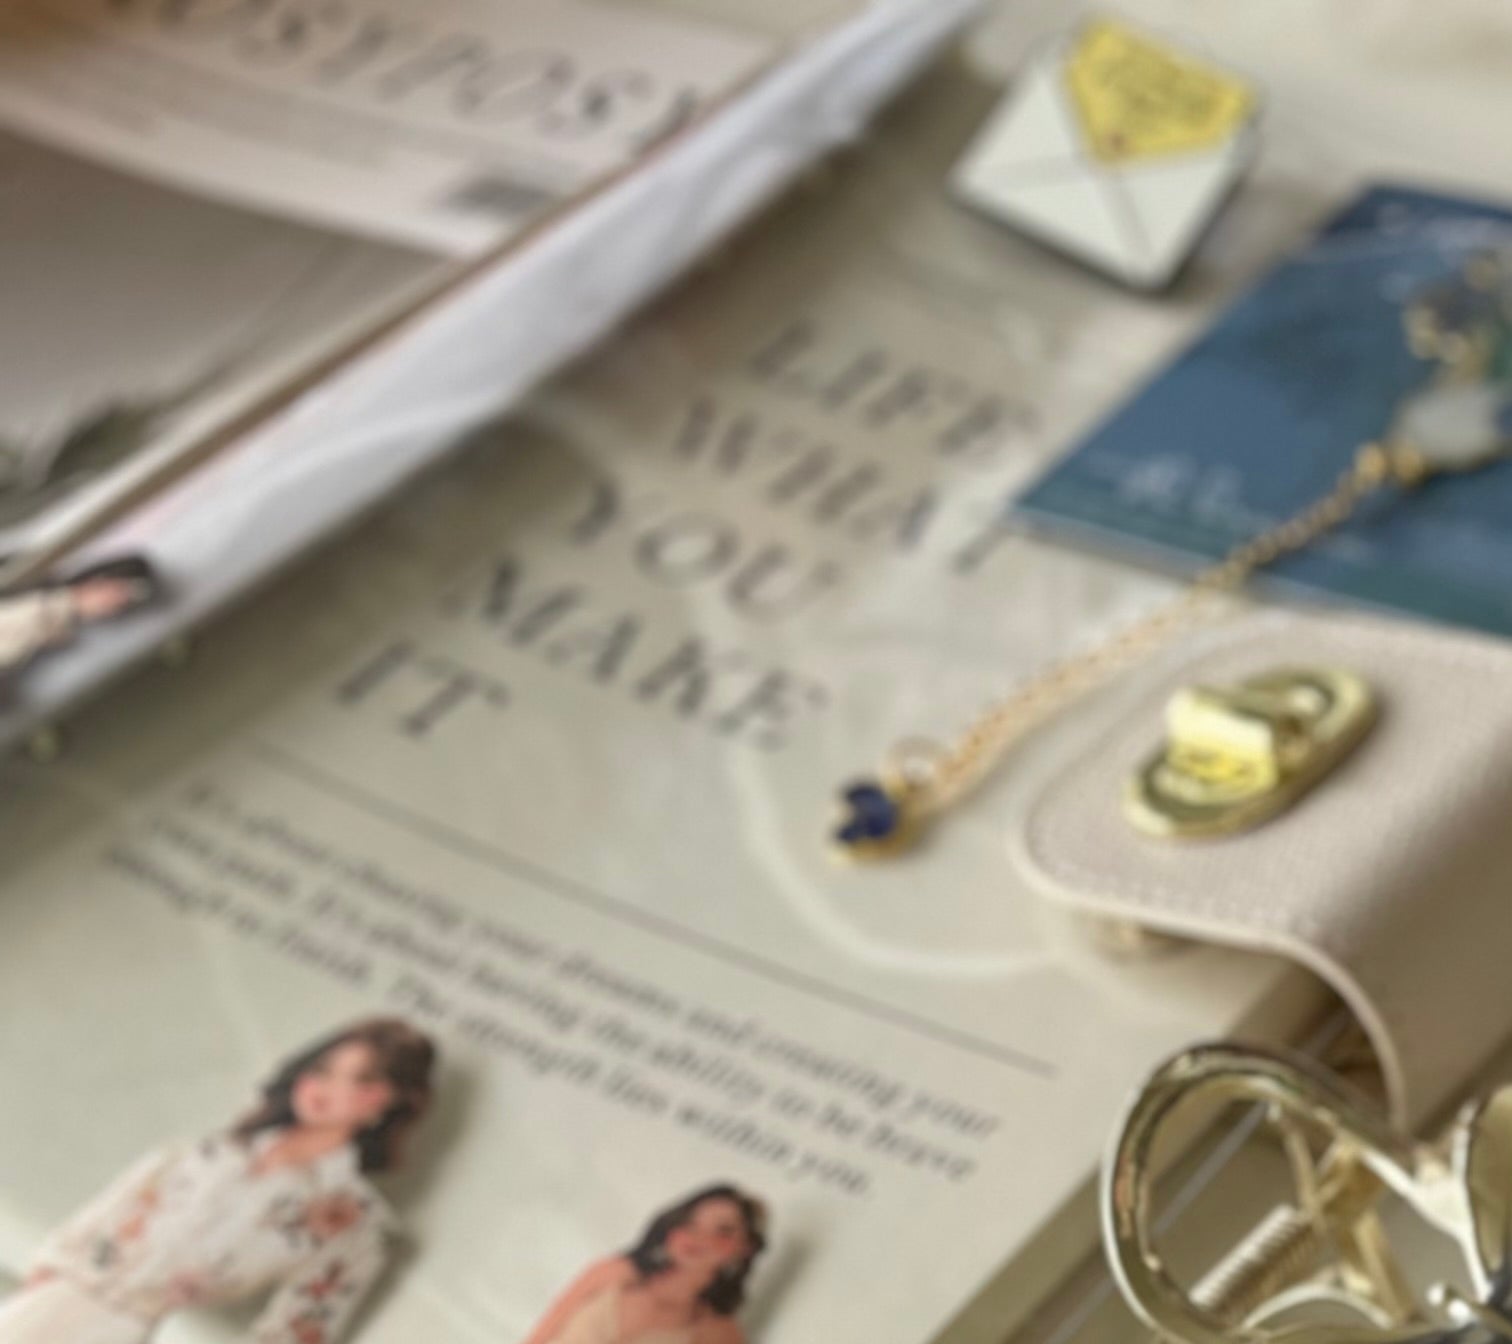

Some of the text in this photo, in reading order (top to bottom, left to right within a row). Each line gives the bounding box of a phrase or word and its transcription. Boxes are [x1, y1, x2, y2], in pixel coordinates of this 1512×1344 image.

[742, 315, 1045, 462] LIFE
[560, 470, 848, 624] YOU
[332, 634, 511, 742] IT
[434, 553, 834, 753] MAKE
